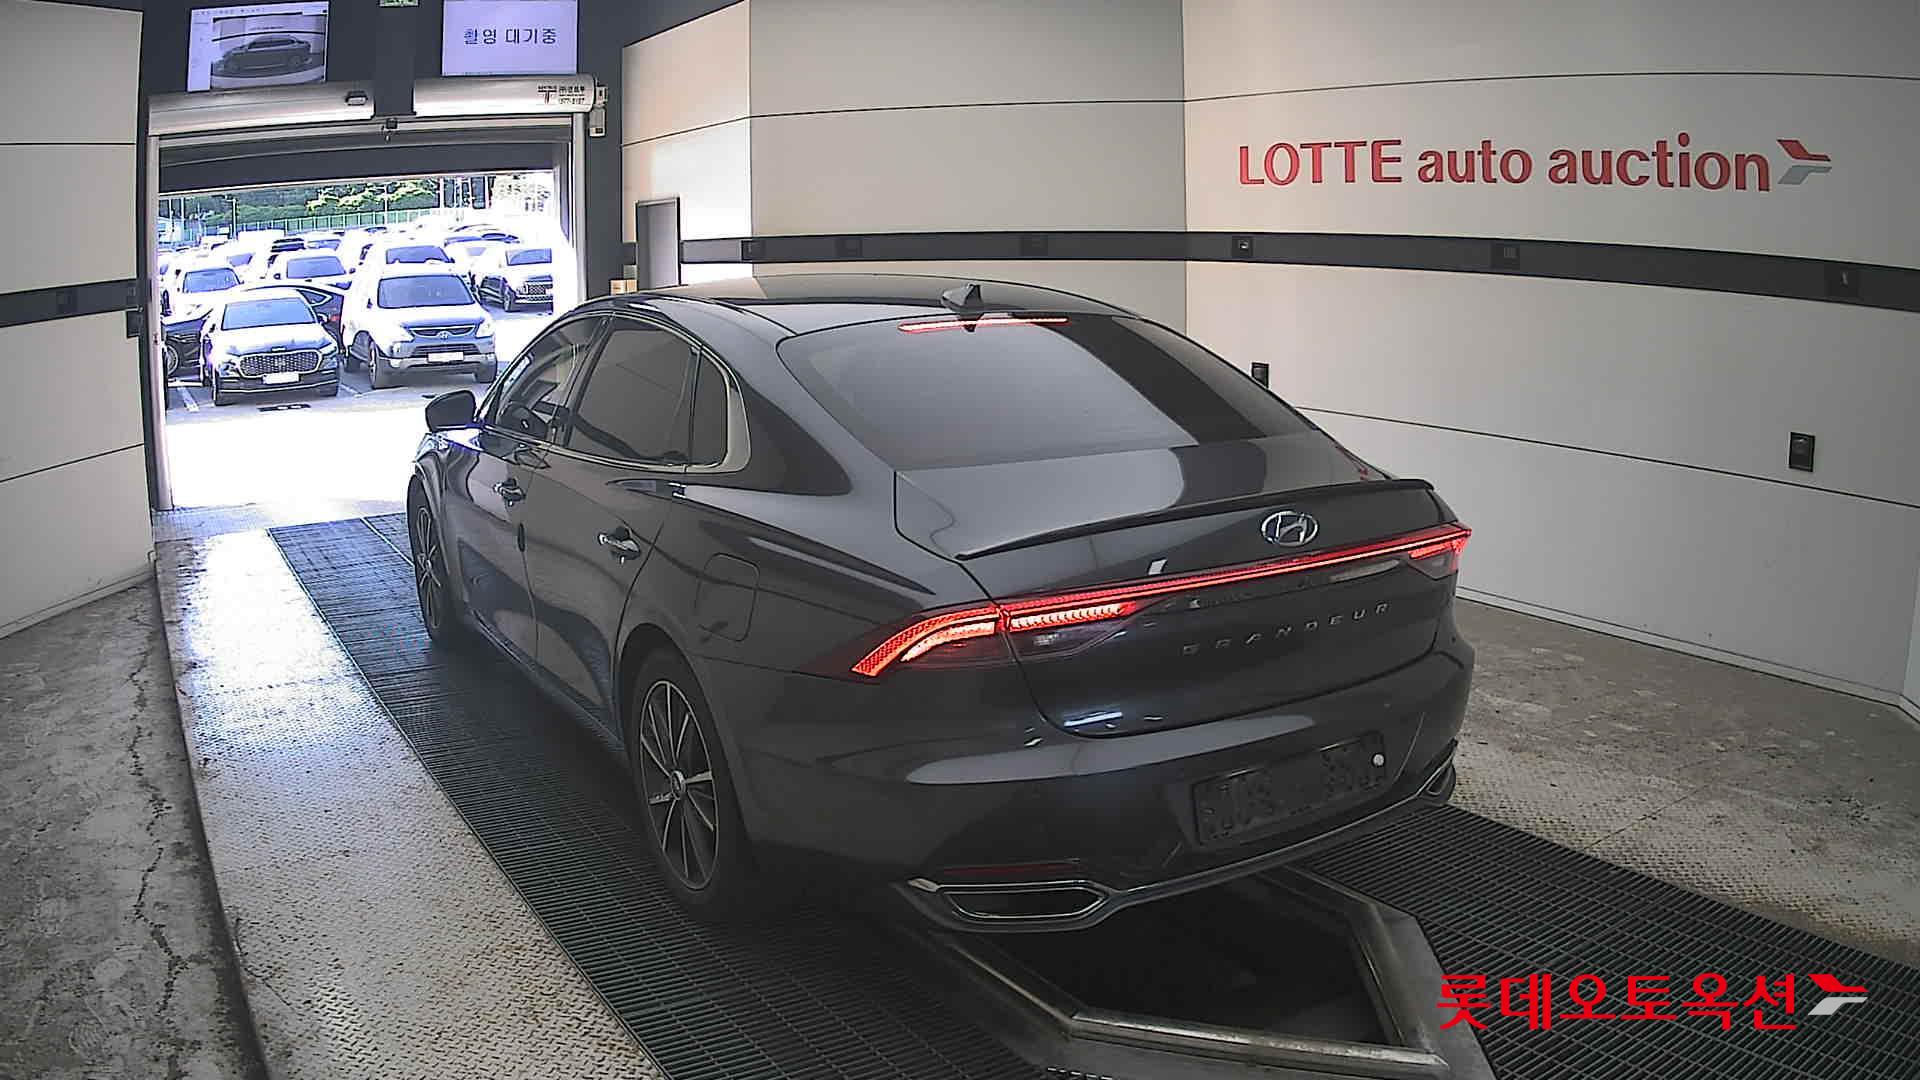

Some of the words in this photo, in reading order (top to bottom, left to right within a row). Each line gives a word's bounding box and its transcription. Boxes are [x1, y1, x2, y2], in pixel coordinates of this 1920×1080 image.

[506, 29, 556, 44] 대기중
[1238, 139, 1402, 186] LOTTE
[1418, 141, 1532, 183] auto
[1548, 132, 1770, 191] auction
[1183, 602, 1389, 654] GRANDEUR
